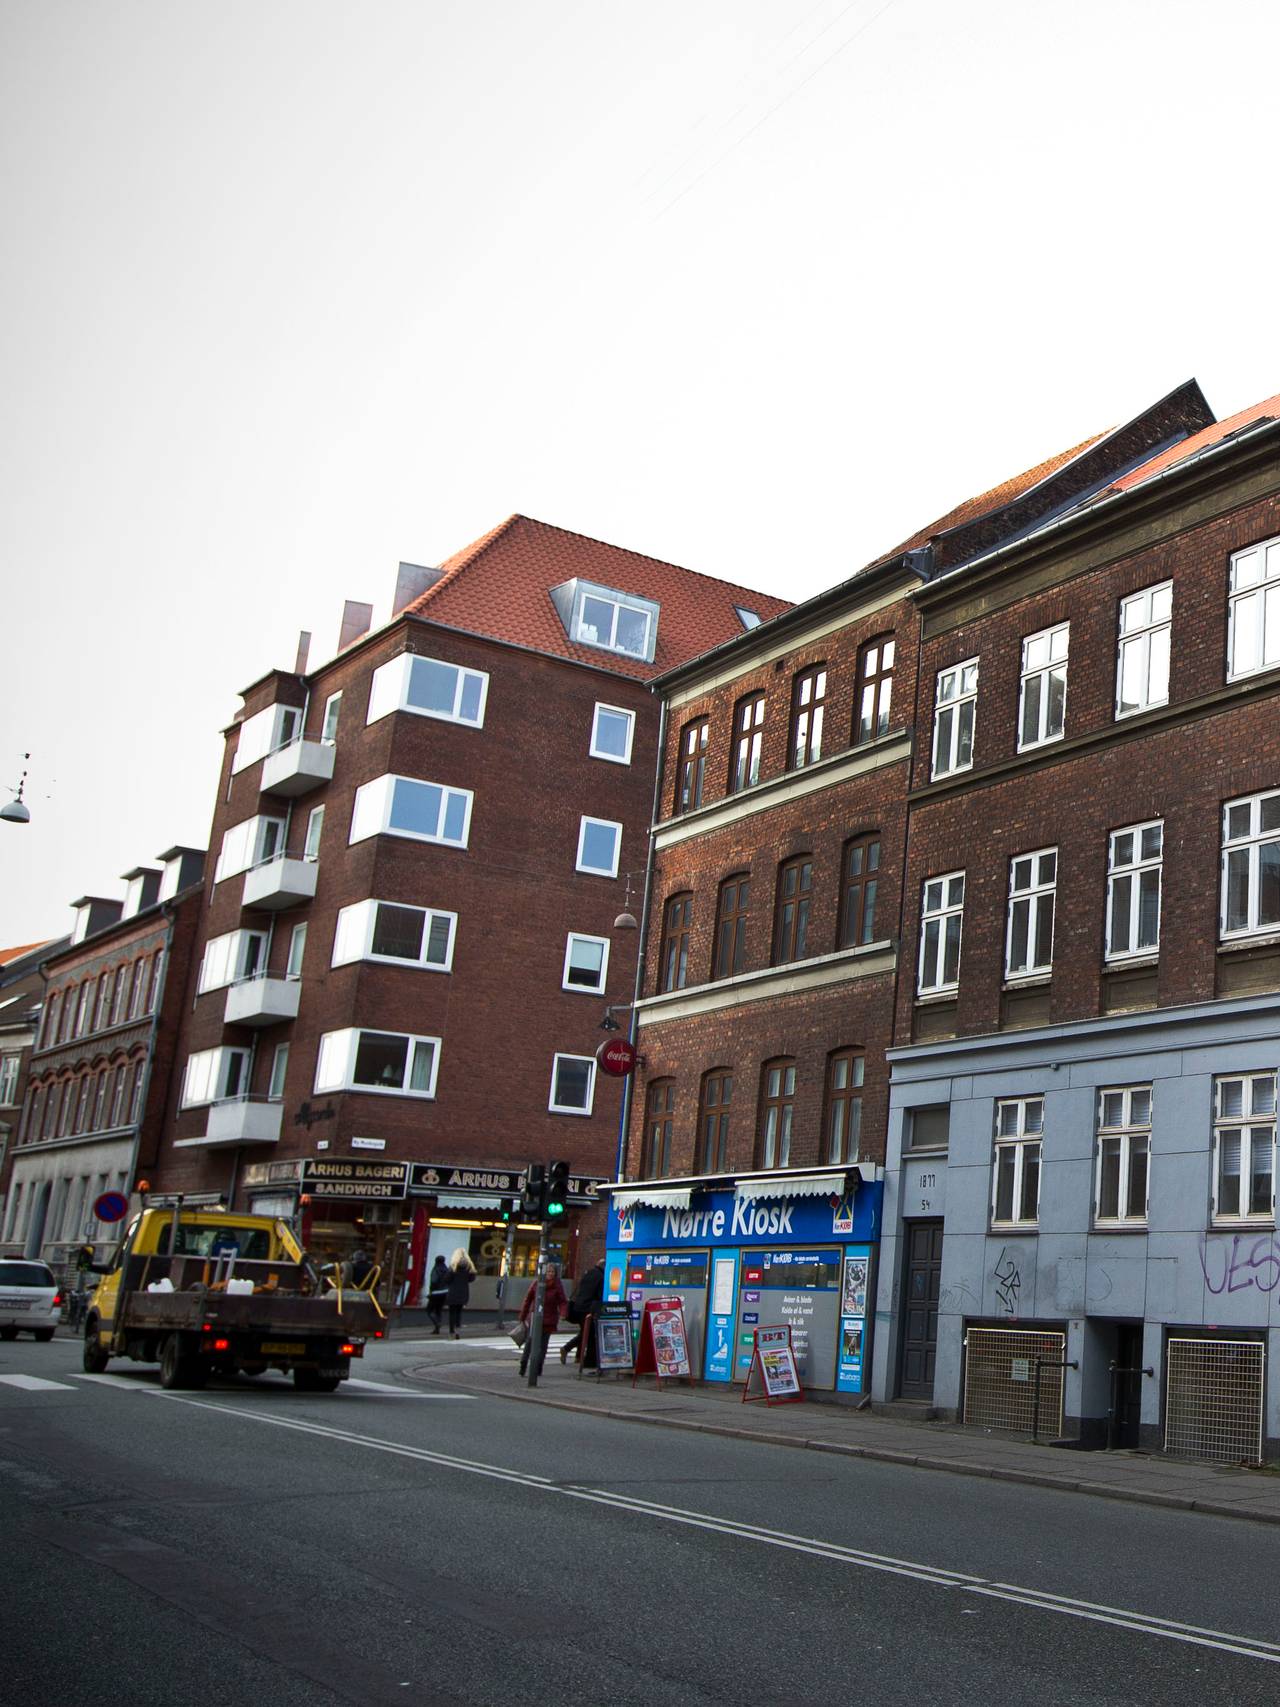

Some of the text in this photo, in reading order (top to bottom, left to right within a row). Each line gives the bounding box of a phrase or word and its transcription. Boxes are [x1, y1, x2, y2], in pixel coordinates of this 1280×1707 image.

[355, 1166, 404, 1179] BAGERI
[920, 1174, 935, 1188] 1877
[315, 1184, 392, 1196] SANDWICH
[921, 1199, 930, 1210] 54
[662, 1198, 795, 1238] Nørre Kiosk
